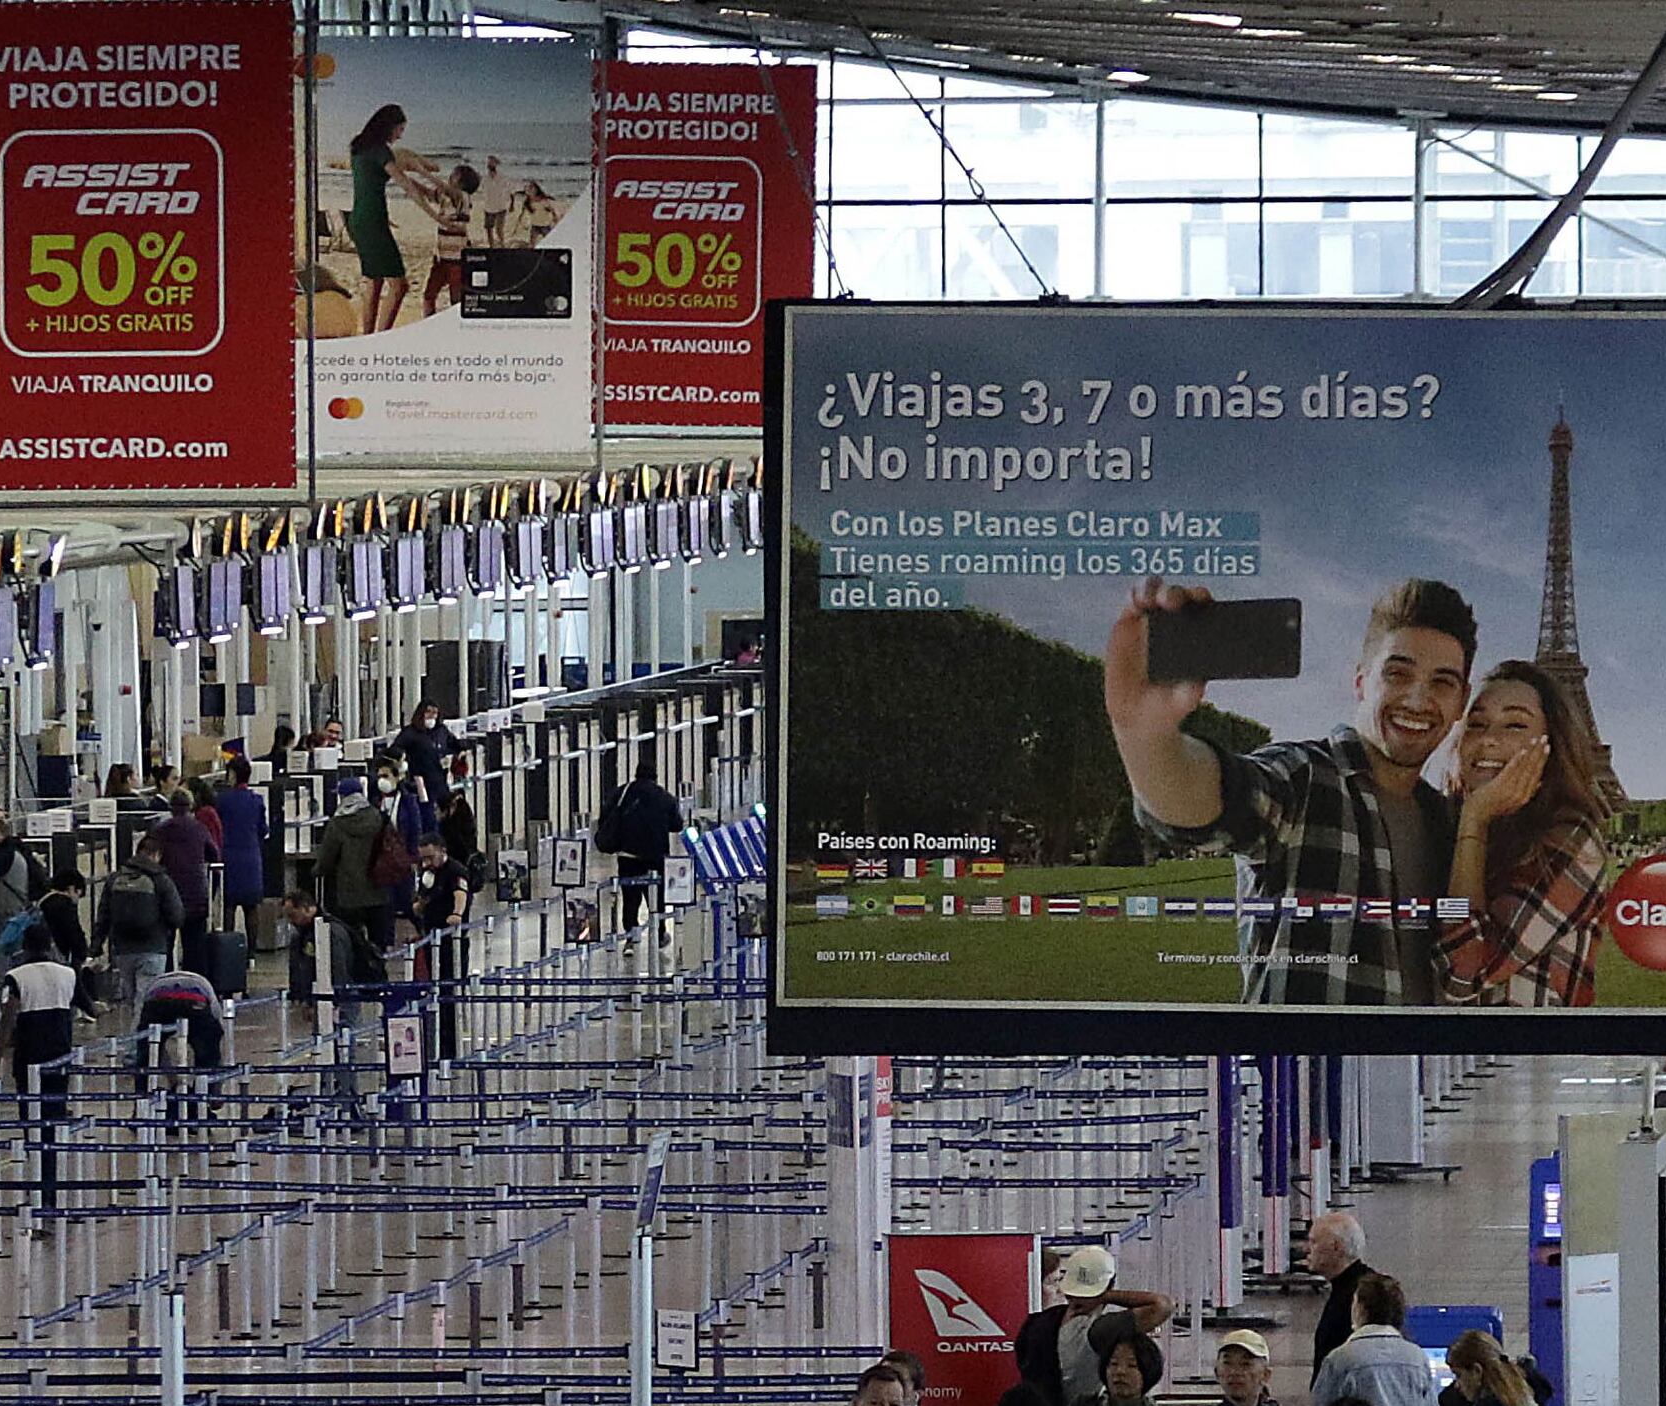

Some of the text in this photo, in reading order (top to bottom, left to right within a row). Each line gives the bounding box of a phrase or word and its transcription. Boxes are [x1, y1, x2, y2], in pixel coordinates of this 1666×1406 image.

[97, 43, 241, 73] SIEMPRE
[8, 80, 218, 109] PROTEGIDO!
[591, 91, 775, 114] VIAJA SIEMPRE
[604, 119, 759, 141] PROTEGIDO!
[23, 163, 191, 188] ASSIST
[614, 181, 738, 199] ASSIST
[76, 190, 201, 216] CARD
[653, 202, 745, 222] CARD
[25, 229, 198, 307] 50%
[613, 232, 742, 289] 50%
[701, 274, 739, 289] OFF
[144, 286, 194, 306] OFF
[626, 293, 675, 308] HIJOS
[680, 293, 738, 309] GRATIS
[25, 312, 195, 334] + HIJOS GRATIS
[602, 338, 752, 355] VIAJA TRANQUILO
[359, 357, 369, 366] a
[374, 354, 431, 367] Hoteles
[434, 357, 452, 366] en
[456, 354, 491, 366] todo
[495, 354, 509, 366] el
[512, 354, 565, 367] mundo
[11, 372, 215, 395] VIAJA TRANQUILO
[313, 372, 336, 382] on
[340, 370, 404, 386] garantía
[409, 371, 428, 383] de
[432, 371, 474, 383] tarifa
[478, 371, 511, 383] más
[817, 370, 1442, 428] ¿Viajas 3, 7 o más días?
[819, 434, 1154, 491] ¡No importa!
[830, 510, 1223, 538] Con los Planes Claro Max
[830, 545, 1257, 582] Tienes roaming los 365 días
[830, 580, 950, 608] del año.
[817, 832, 998, 854] Países con Roaming:
[816, 951, 835, 962] 800
[838, 951, 856, 962] 171
[859, 951, 877, 962] 171
[886, 950, 950, 962] clarochile.cl
[936, 1341, 1015, 1353] QANTAS
[919, 1386, 963, 1399] nomy
